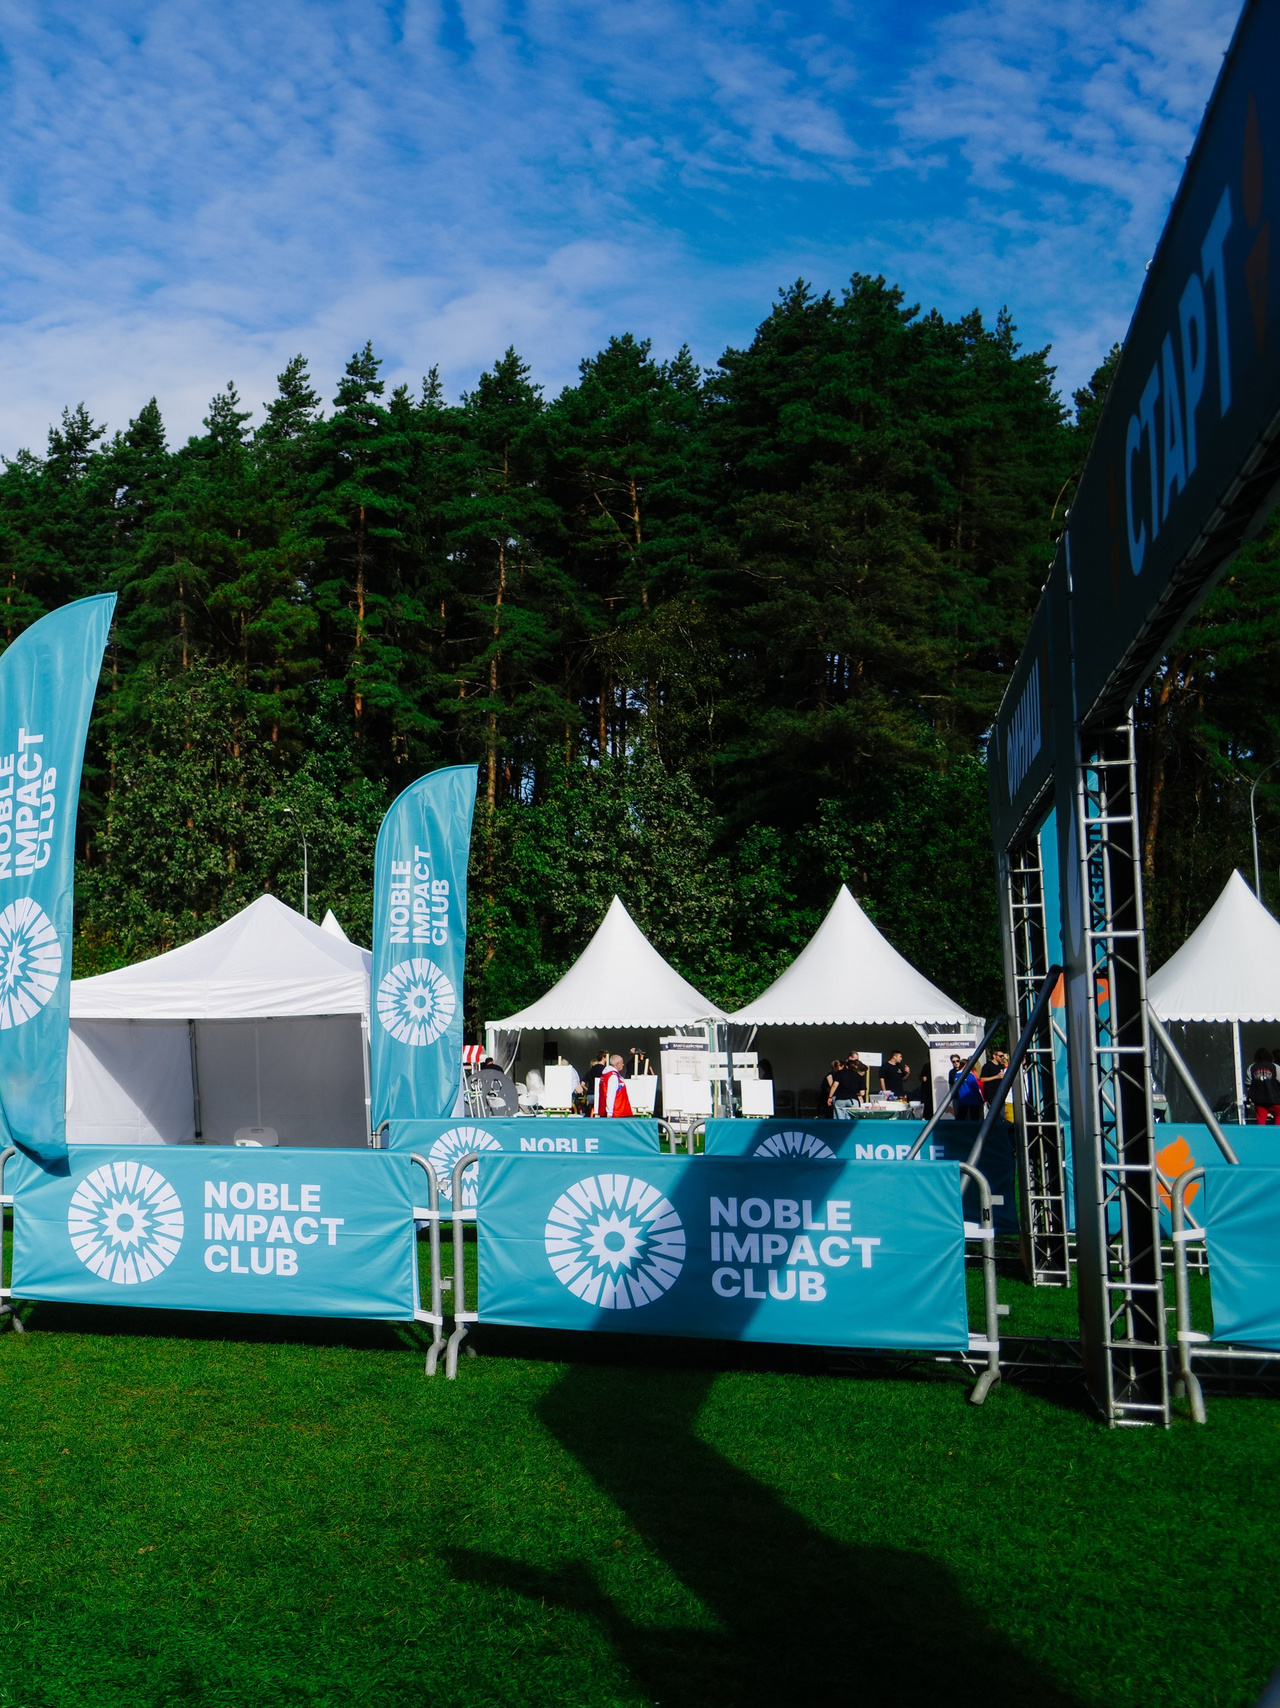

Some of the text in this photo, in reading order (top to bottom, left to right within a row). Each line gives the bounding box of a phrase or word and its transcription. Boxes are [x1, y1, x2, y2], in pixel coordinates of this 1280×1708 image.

[1124, 183, 1233, 578] СТАРТ
[15, 727, 44, 877] IMPACT
[33, 766, 58, 870] CLUB
[389, 859, 412, 944] NOBLE
[412, 845, 432, 945] IMPACT
[431, 879, 450, 946] CLUB
[520, 1137, 599, 1153] NOBLE
[204, 1181, 321, 1213] NOBLE
[711, 1196, 853, 1232] NOBLE
[204, 1213, 344, 1246] IMPACT
[204, 1245, 298, 1276] CLUB
[711, 1232, 881, 1268] IMPACT
[711, 1267, 827, 1302] CLUB
